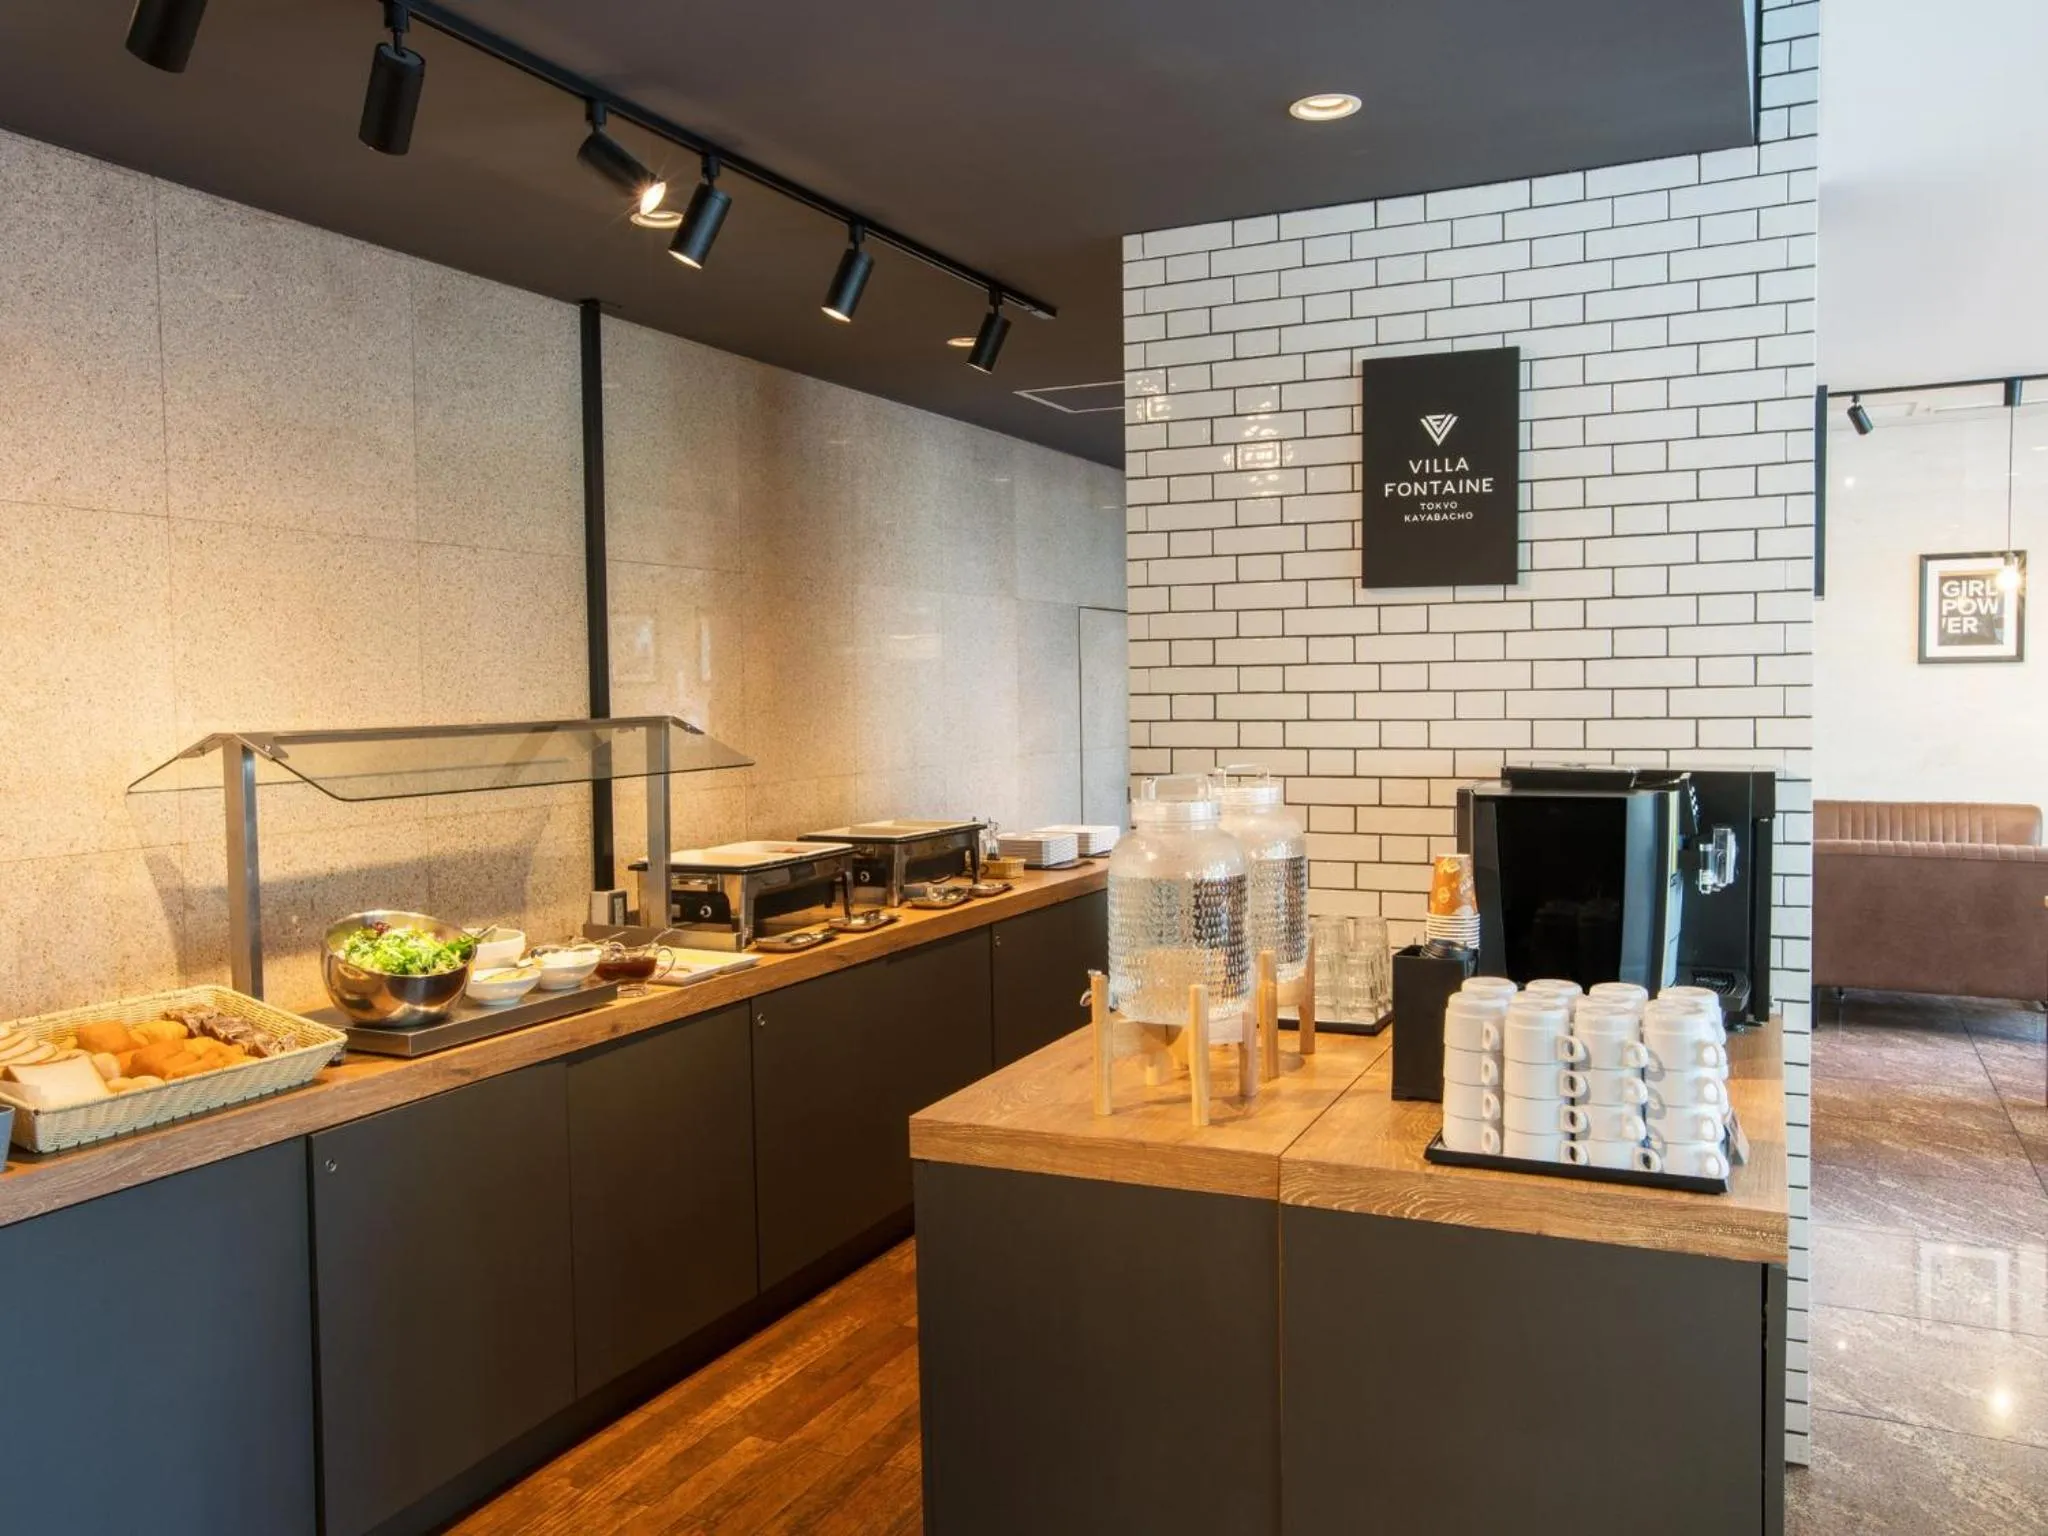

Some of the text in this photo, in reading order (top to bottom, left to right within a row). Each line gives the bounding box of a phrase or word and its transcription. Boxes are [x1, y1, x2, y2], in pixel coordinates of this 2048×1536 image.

[1409, 457, 1469, 474] VILLA
[1384, 477, 1494, 498] FONTAINE
[1420, 501, 1458, 511] TOKYO
[1404, 511, 1475, 522] KAYABACHO
[1942, 580, 1998, 597] GIRL
[1942, 598, 1998, 615] POW
